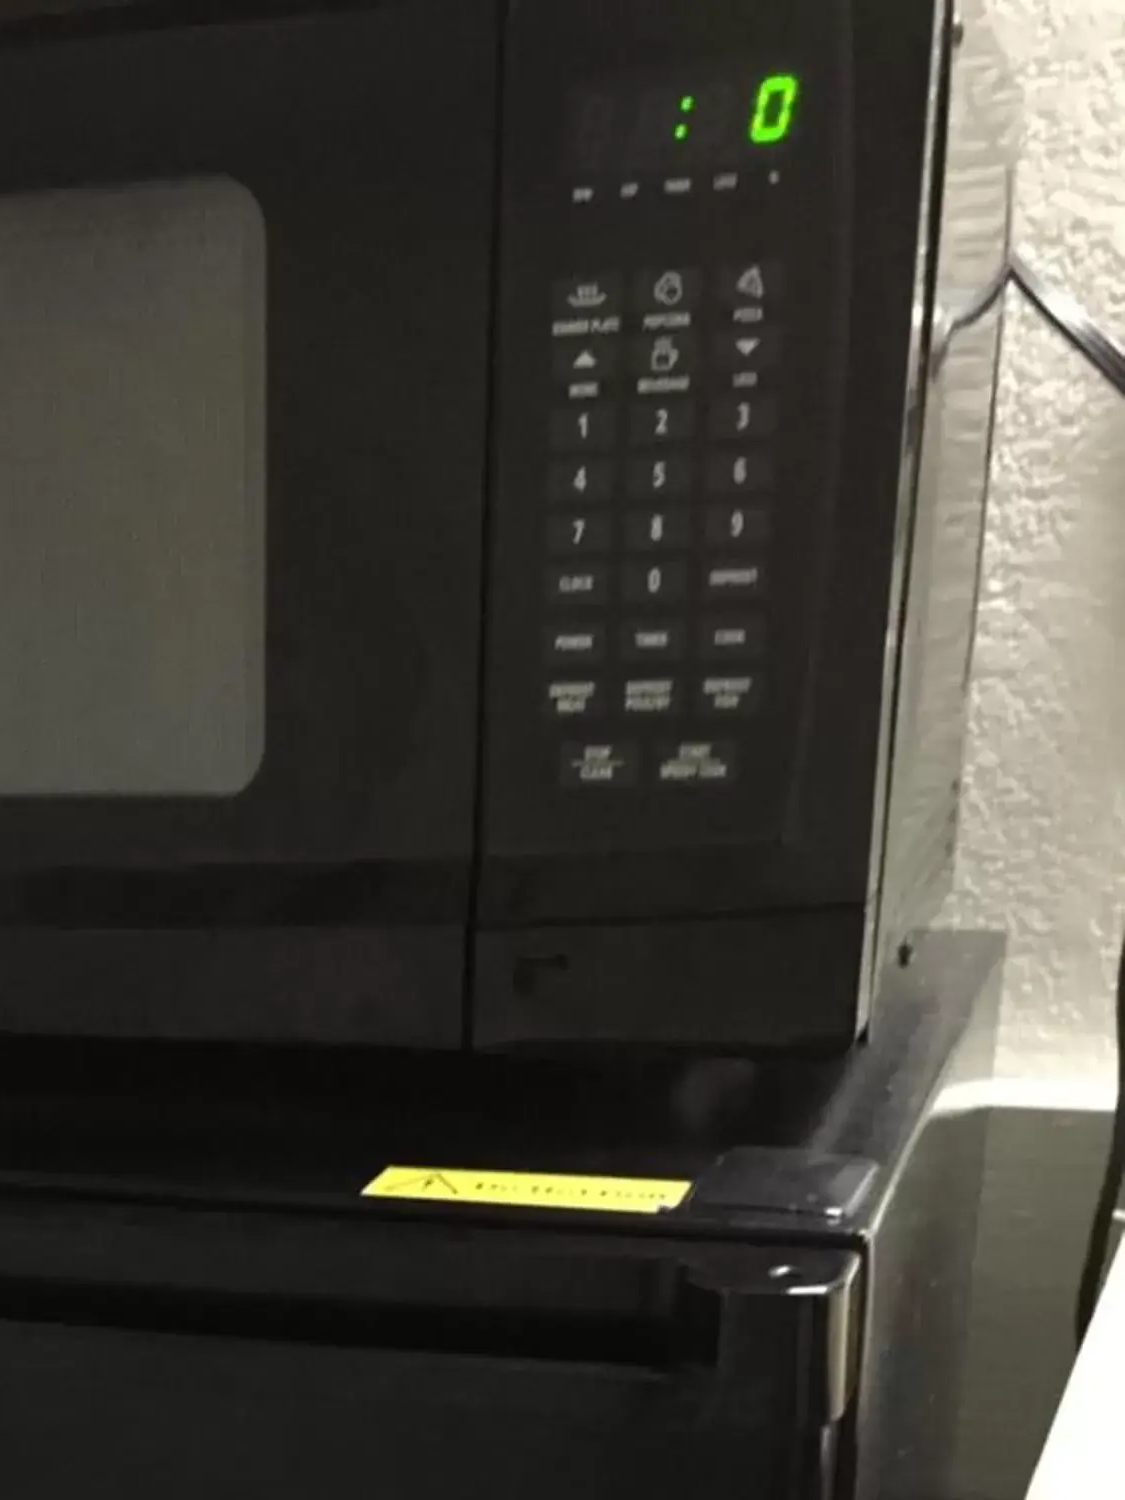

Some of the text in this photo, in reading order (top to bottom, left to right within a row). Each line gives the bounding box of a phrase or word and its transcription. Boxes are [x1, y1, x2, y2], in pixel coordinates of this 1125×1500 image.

[578, 411, 588, 439] 1
[654, 407, 668, 435] 2
[736, 401, 751, 431] 3
[572, 465, 587, 492] 4
[652, 460, 666, 488] 5
[572, 518, 585, 544] 7
[650, 513, 663, 541] 8
[730, 510, 744, 538] 9
[647, 566, 661, 593] 0
